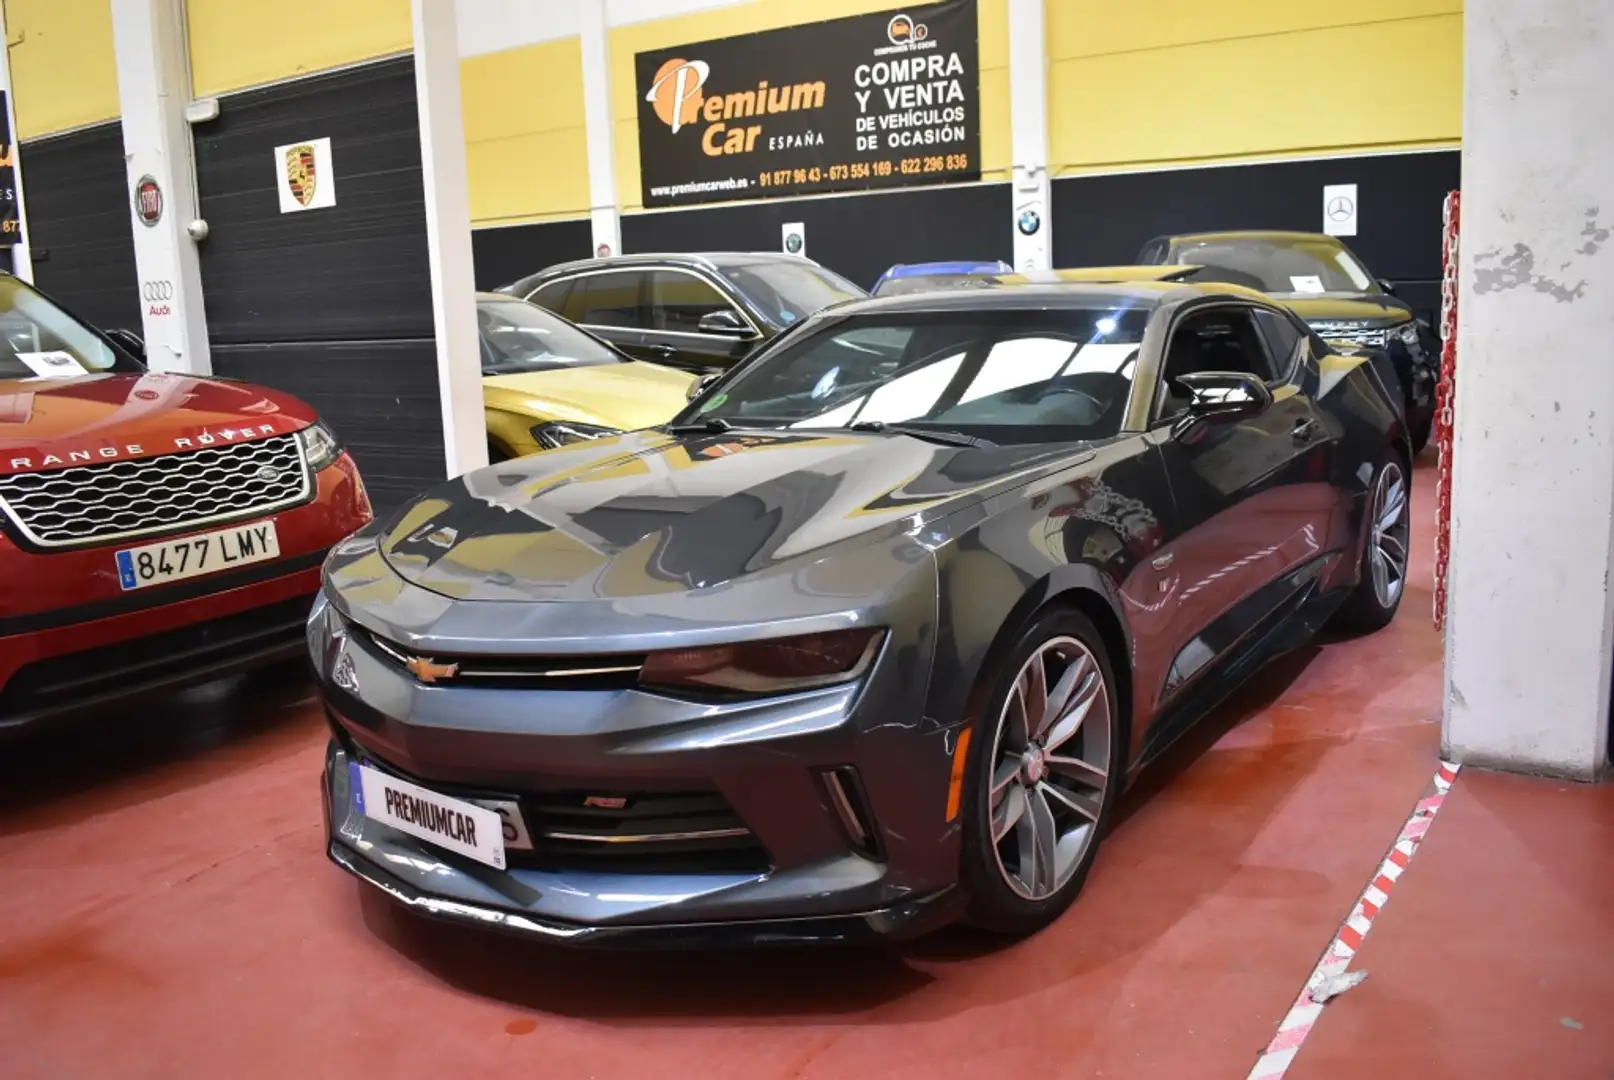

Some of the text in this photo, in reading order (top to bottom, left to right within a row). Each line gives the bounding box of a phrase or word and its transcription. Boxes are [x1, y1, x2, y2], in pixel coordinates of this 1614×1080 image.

[854, 52, 964, 88] COMPRA
[645, 59, 826, 134] Premium
[854, 79, 965, 113] Y VENTA
[856, 106, 965, 132] DE VEHÍCULOS
[702, 122, 762, 157] Car
[769, 130, 824, 150] ESPAÑA
[856, 123, 965, 151] DE OCASIÓN
[651, 177, 748, 198] www.premiumcarweb.es
[760, 171, 771, 188] 91
[773, 169, 792, 186] 877
[808, 166, 821, 182] 43
[829, 164, 849, 180] 673
[850, 162, 869, 179] 554
[901, 157, 921, 174] 622
[923, 155, 944, 172] 296
[946, 153, 968, 170] 836
[149, 304, 171, 317] Audi
[10, 425, 275, 469] RANGE ROVER
[136, 526, 269, 580] 8477 LMY
[384, 786, 478, 848] PREMIUMCAR
